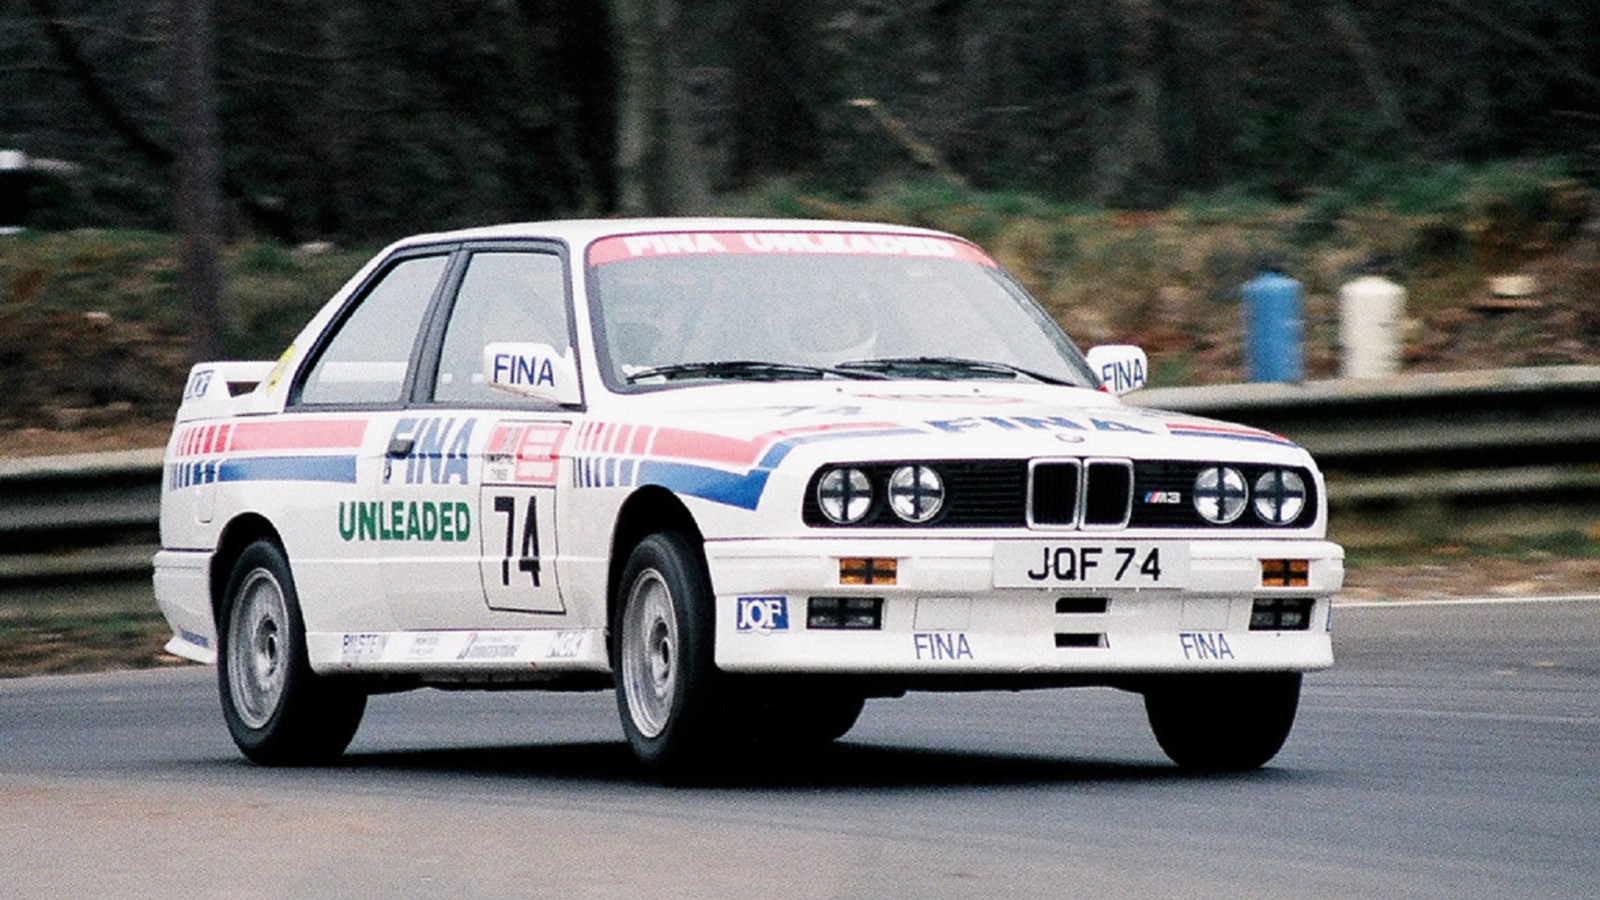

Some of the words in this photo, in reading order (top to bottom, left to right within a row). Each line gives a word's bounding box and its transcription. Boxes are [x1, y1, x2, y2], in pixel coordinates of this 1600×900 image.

[624, 232, 728, 256] FINA
[740, 232, 956, 256] UNLEADED
[493, 354, 555, 387] FINA
[1102, 358, 1146, 392] FINA
[923, 416, 1157, 434] FINA
[383, 417, 477, 485] FINA
[1154, 491, 1182, 503] M3
[339, 501, 471, 542] UNLEADED
[494, 496, 540, 588] 74
[1028, 547, 1103, 582] JQF
[1115, 547, 1162, 582] 74
[914, 633, 974, 660] FINA
[1179, 632, 1235, 660] FINA
